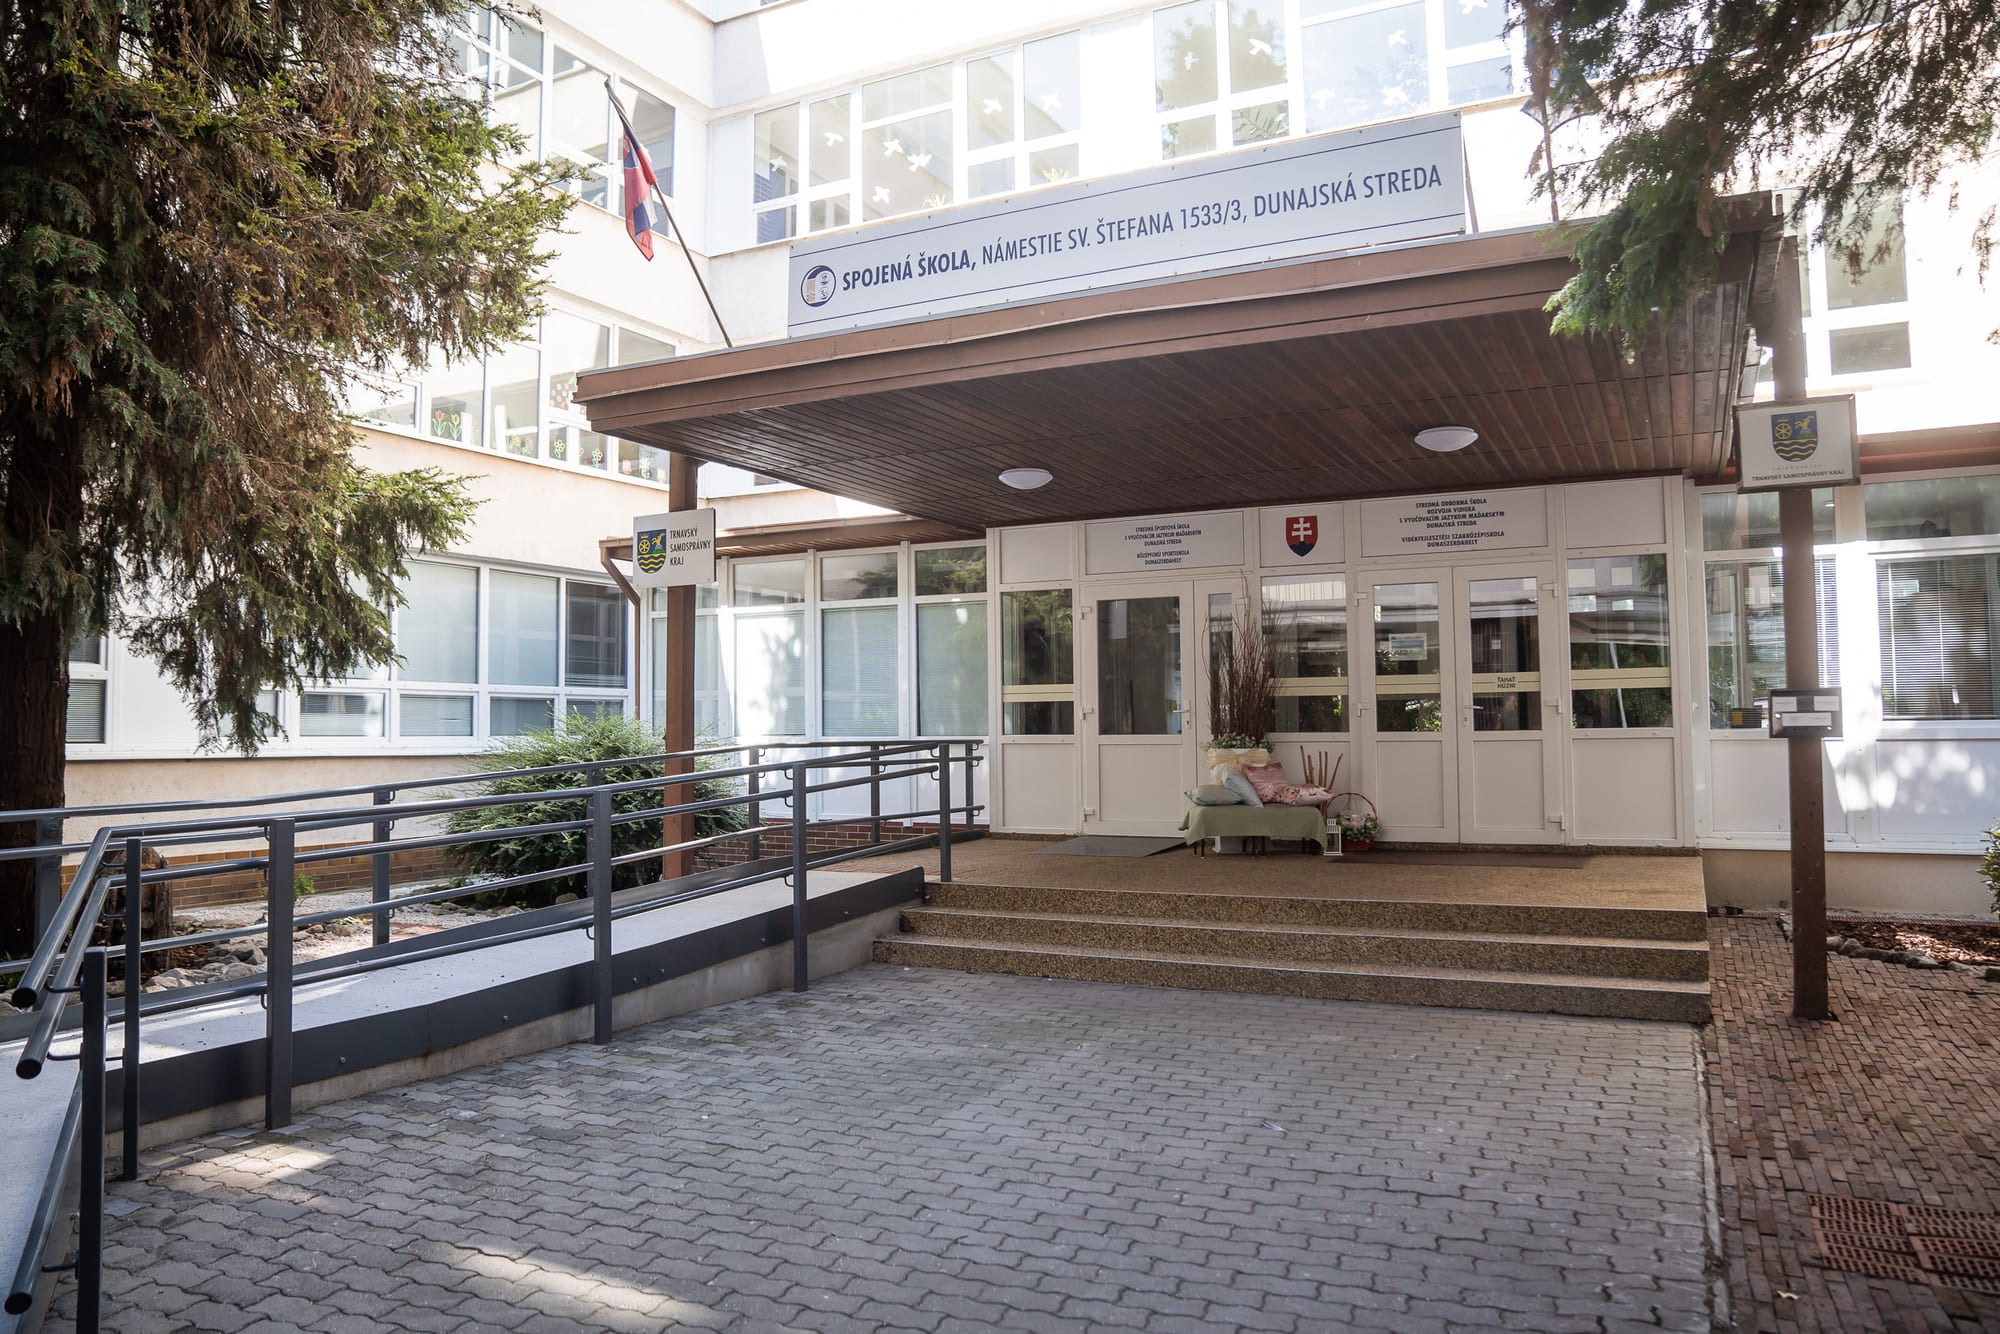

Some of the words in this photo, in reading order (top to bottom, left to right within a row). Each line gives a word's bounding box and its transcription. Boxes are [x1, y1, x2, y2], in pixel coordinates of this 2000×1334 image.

[843, 254, 912, 291] SPOJENÁ
[918, 249, 976, 277] ŠKOLA,
[982, 232, 1062, 265] NÁMESTIE
[1068, 227, 1090, 250] SV.
[1097, 211, 1174, 244] ŠTEFANA
[1180, 199, 1246, 229] 1533/3,
[1254, 172, 1357, 217] DUNAJSKÁ
[1363, 164, 1442, 198] STREDA
[1415, 499, 1440, 508] STREDNÁ
[1440, 498, 1468, 507] ODBORNÁ
[1469, 497, 1487, 505] ŠKOLA
[1426, 507, 1452, 515] ROZVOJA
[1440, 513, 1467, 521] JAZYKOM
[1426, 521, 1455, 529] DUNAJSKÁ
[670, 525, 698, 539] TRNAVSKÝ
[1427, 539, 1478, 548] DUNASZERDAHELY
[670, 556, 684, 566] KRAJ
